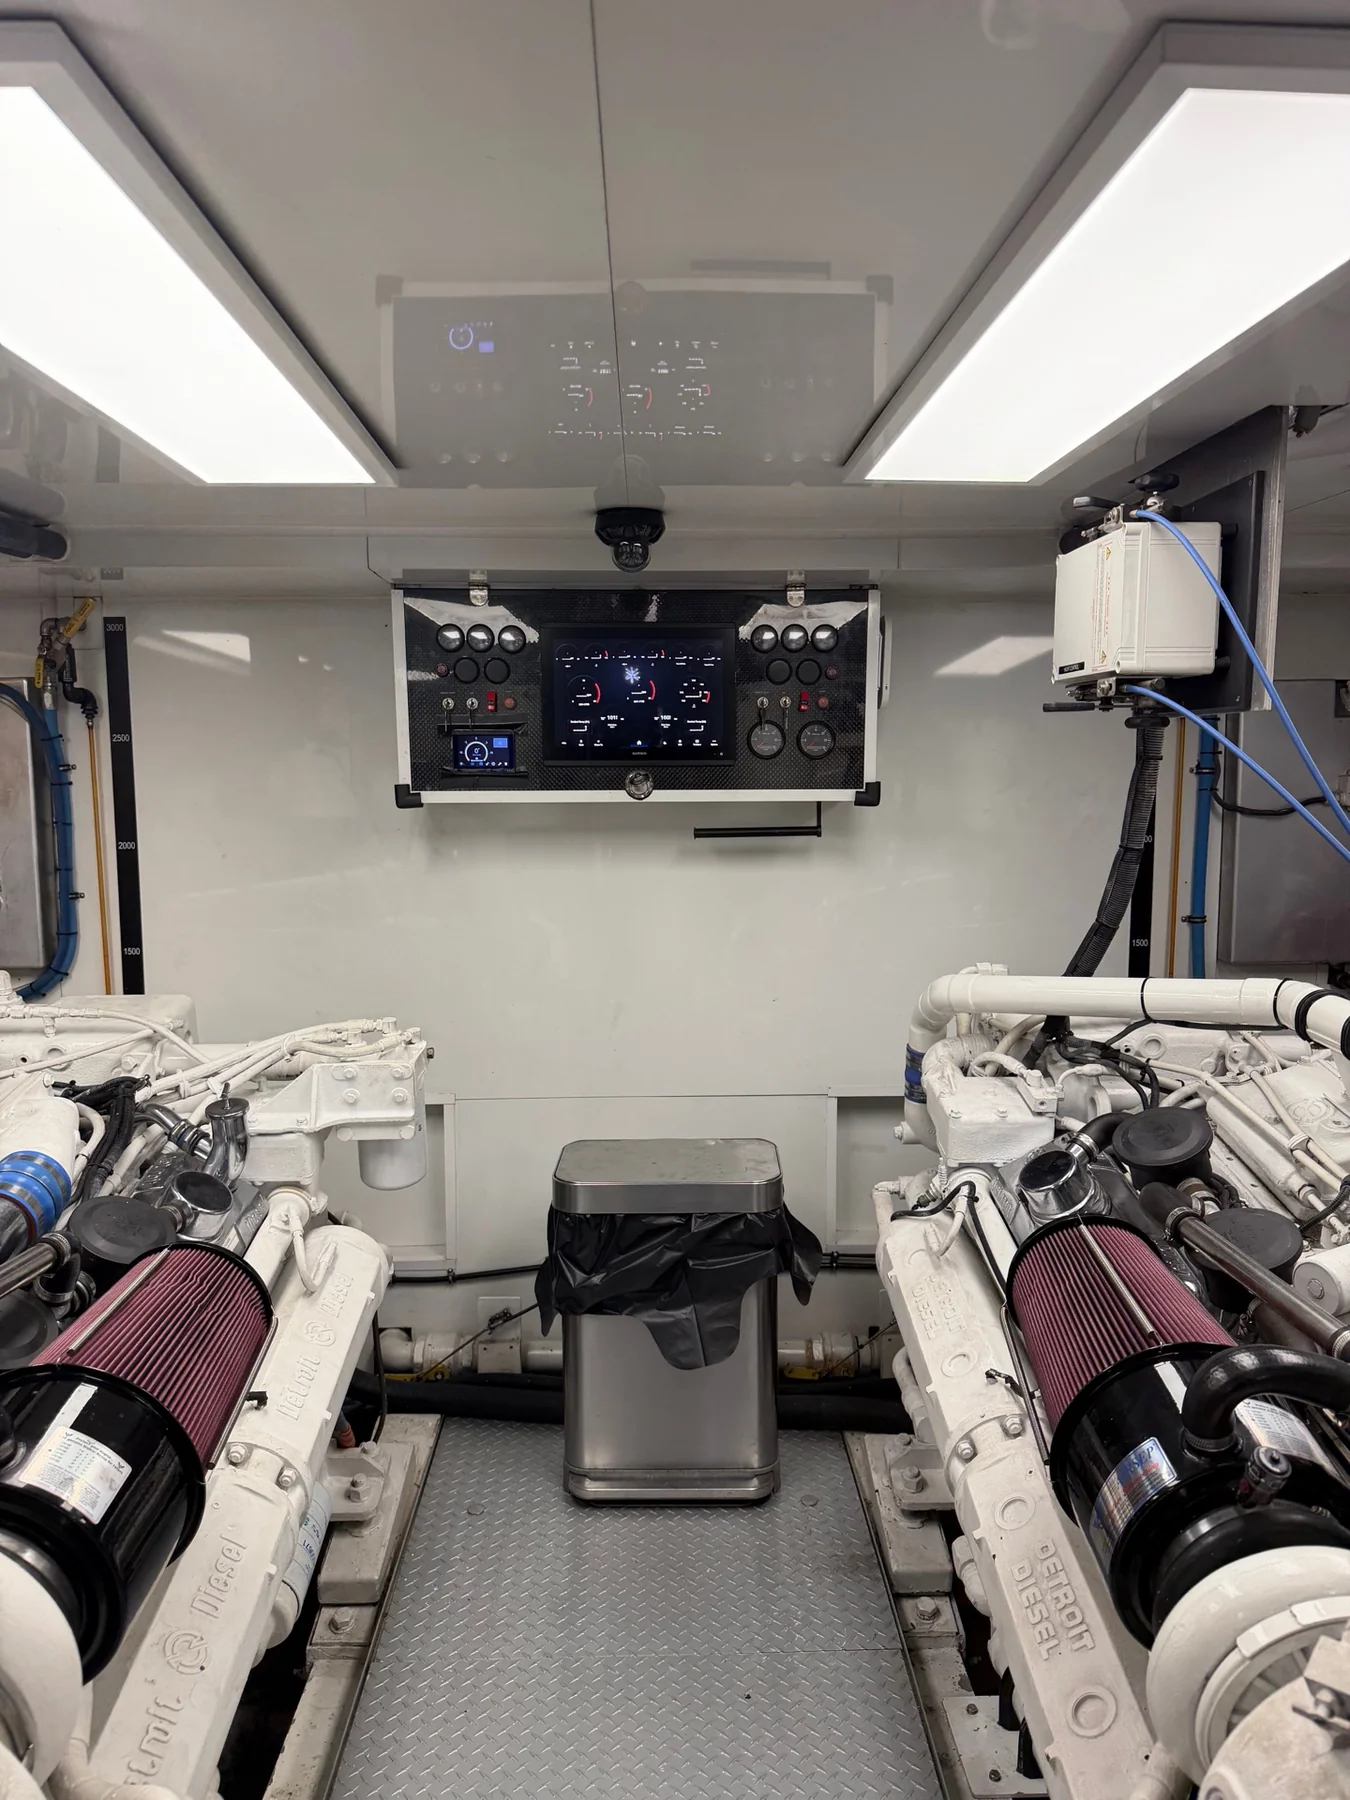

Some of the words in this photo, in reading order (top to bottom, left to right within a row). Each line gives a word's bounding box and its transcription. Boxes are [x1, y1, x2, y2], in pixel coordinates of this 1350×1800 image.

[106, 623, 124, 632] 3000
[112, 734, 130, 742] 2500
[1144, 835, 1152, 843] 00
[118, 842, 136, 850] 2000
[1132, 939, 1149, 947] 1500
[123, 947, 141, 955] 1500
[276, 1356, 320, 1421] Detroit
[319, 1273, 354, 1319] Diesel
[1034, 1538, 1096, 1653] DETROIT
[1011, 1557, 1061, 1661] DIESEL
[124, 1695, 185, 1786] troit
[190, 1534, 248, 1619] Diesel
